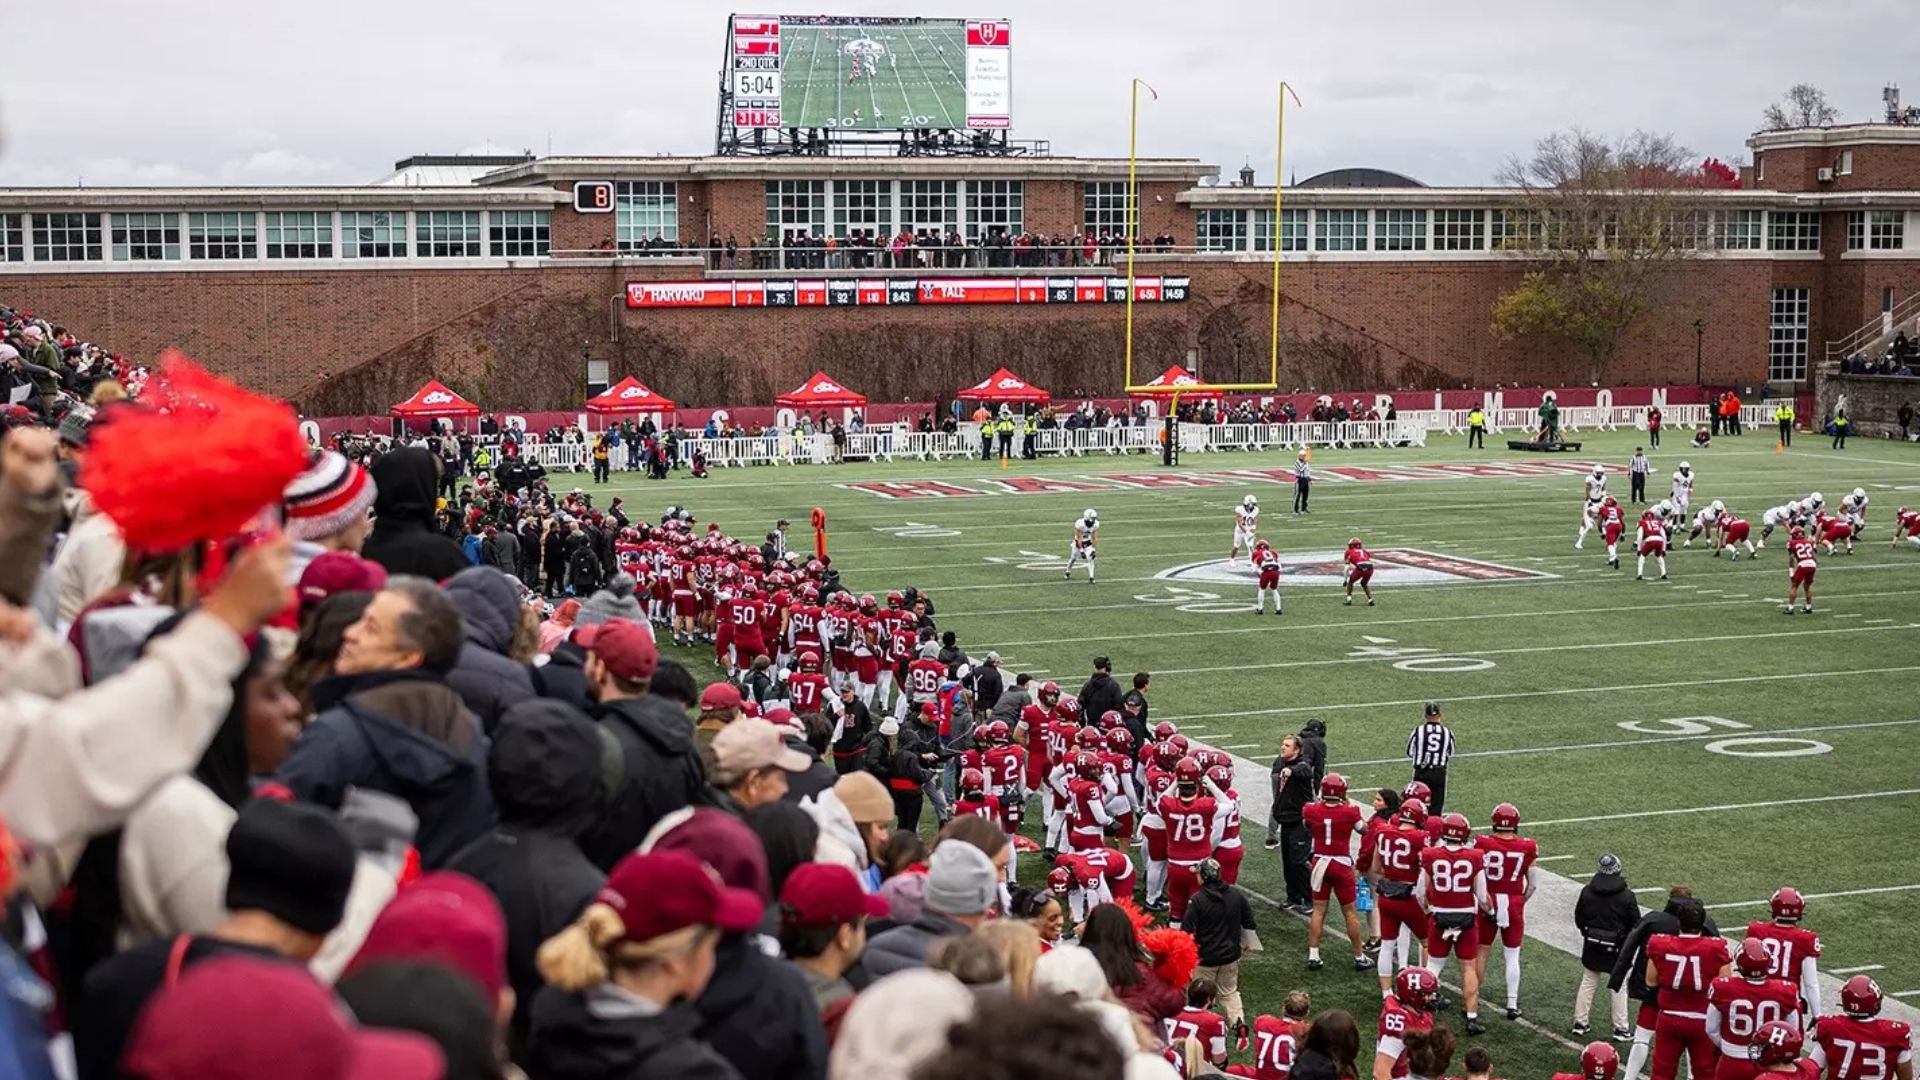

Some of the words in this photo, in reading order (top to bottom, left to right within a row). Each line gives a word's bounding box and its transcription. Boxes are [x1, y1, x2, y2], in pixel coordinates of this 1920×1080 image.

[741, 75, 774, 94] 5:04
[740, 112, 747, 124] 3
[754, 112, 762, 124] 8
[767, 113, 779, 124] 26
[595, 186, 608, 207] 8
[651, 287, 705, 302] HARVARD
[837, 292, 848, 304] 92
[940, 285, 966, 298] YALE
[1795, 543, 1813, 558] 22
[636, 570, 646, 586] 4
[672, 564, 684, 580] 91
[733, 606, 755, 625] 50
[793, 613, 814, 633] 64
[893, 635, 905, 655] 16
[1344, 634, 1497, 673] 40
[913, 669, 937, 692] 86
[792, 682, 816, 705] 47
[1427, 733, 1441, 752] S
[1616, 715, 1834, 758] 50
[1004, 755, 1019, 781] 2
[1168, 814, 1205, 842] 78
[1323, 818, 1331, 846] 1
[1378, 833, 1411, 870] 42
[1432, 859, 1474, 893] 82
[1484, 850, 1526, 882] 87
[1763, 937, 1793, 978] 81
[1407, 973, 1421, 990] H
[1664, 954, 1703, 991] 71
[1385, 1012, 1404, 1032] 65
[1728, 1000, 1781, 1037] 60
[1769, 1027, 1787, 1046] H
[1257, 1031, 1296, 1070] 70
[1832, 1038, 1886, 1080] 73
